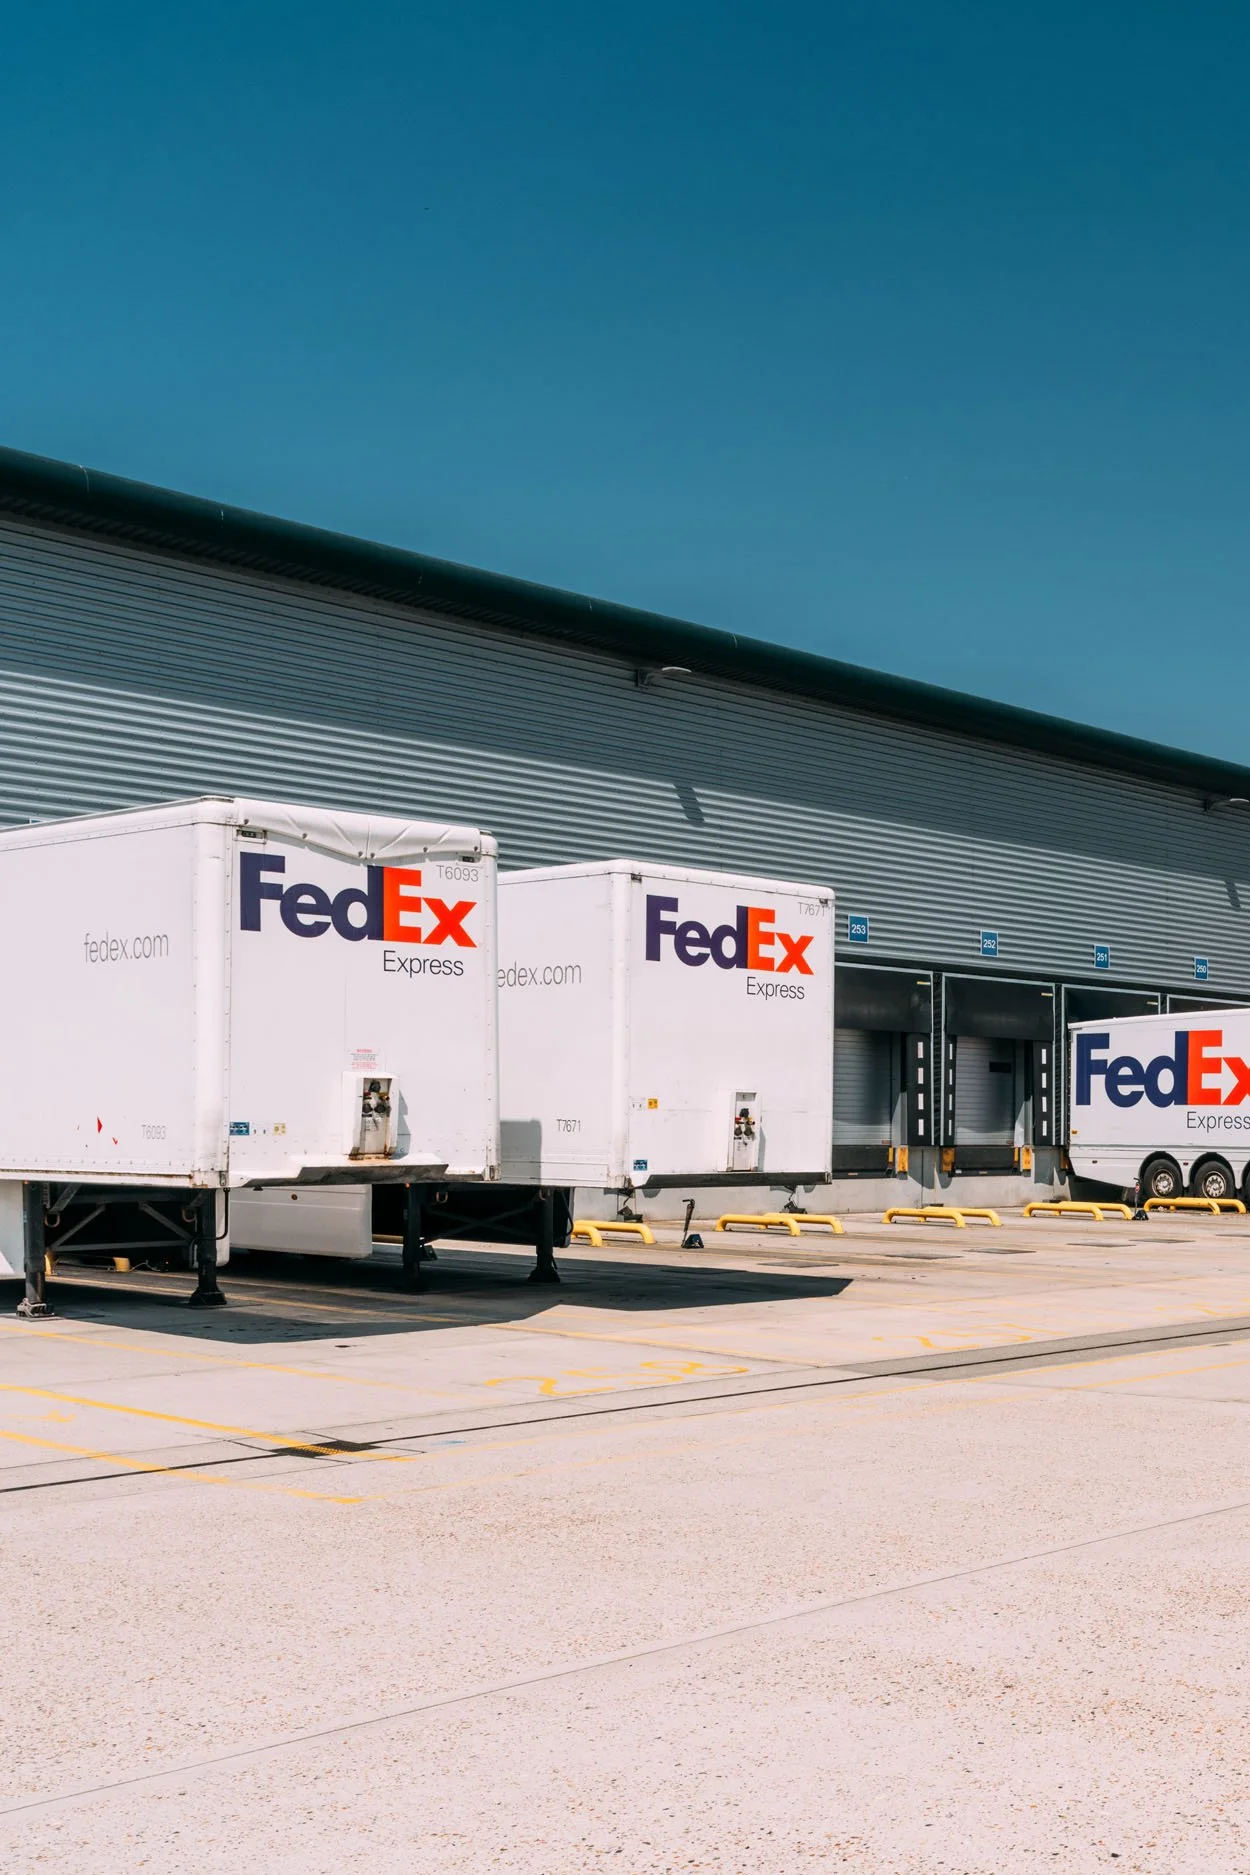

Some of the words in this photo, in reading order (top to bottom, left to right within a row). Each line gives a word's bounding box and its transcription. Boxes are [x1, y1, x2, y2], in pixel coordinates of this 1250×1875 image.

[435, 864, 480, 882] T6093
[240, 851, 478, 948] FedEx
[797, 901, 825, 917] T7671
[645, 894, 815, 976] FedEx
[851, 923, 867, 935] 253
[84, 931, 170, 964] fedex.com
[983, 938, 996, 949] 252
[382, 949, 465, 978] Express
[1096, 952, 1108, 963] 251
[496, 960, 582, 988] edex.com
[1196, 964, 1207, 974] 250
[746, 976, 806, 1001] Express
[142, 1124, 167, 1141] T6093
[556, 1118, 582, 1134] T7671
